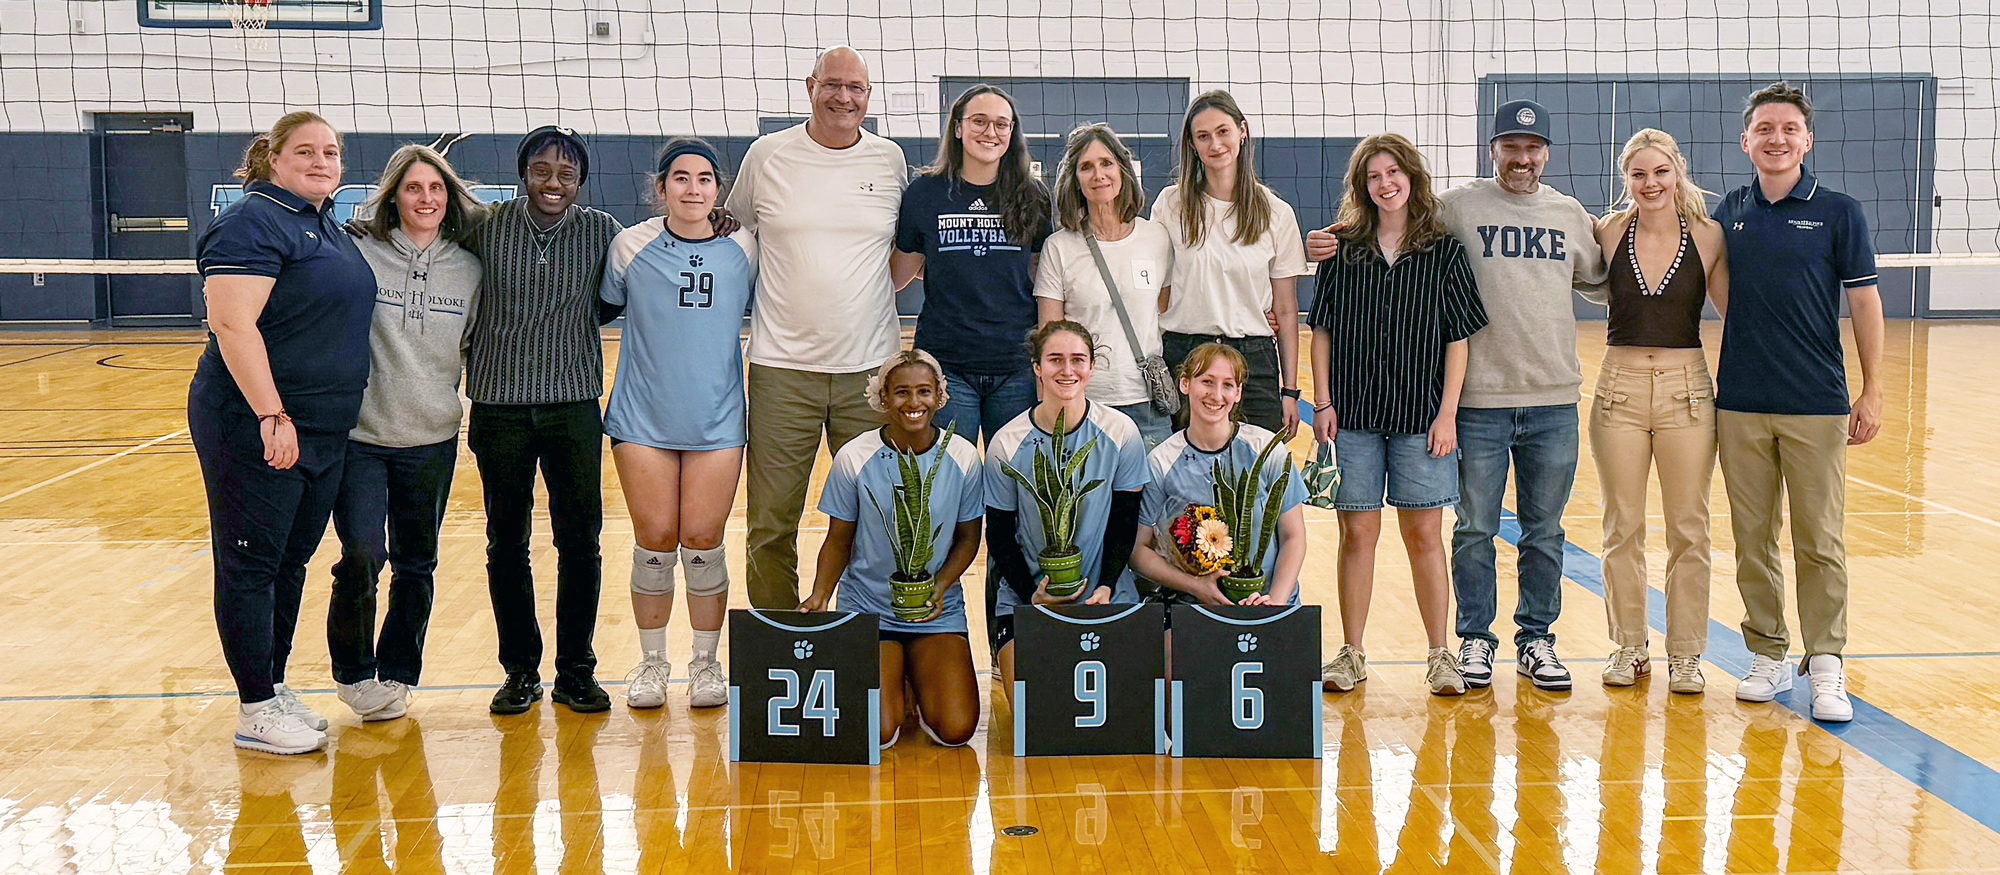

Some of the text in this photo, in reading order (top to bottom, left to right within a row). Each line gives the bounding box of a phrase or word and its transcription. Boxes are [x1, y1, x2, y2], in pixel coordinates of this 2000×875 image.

[938, 218, 1004, 230] MOUNT HOLY
[938, 229, 1007, 244] VOLLEYBA
[1477, 225, 1566, 261] YOKE
[678, 270, 715, 309] 29
[1140, 269, 1150, 285] 9
[767, 668, 840, 738] 24
[1074, 660, 1107, 728] 9
[1231, 661, 1265, 730] 6
